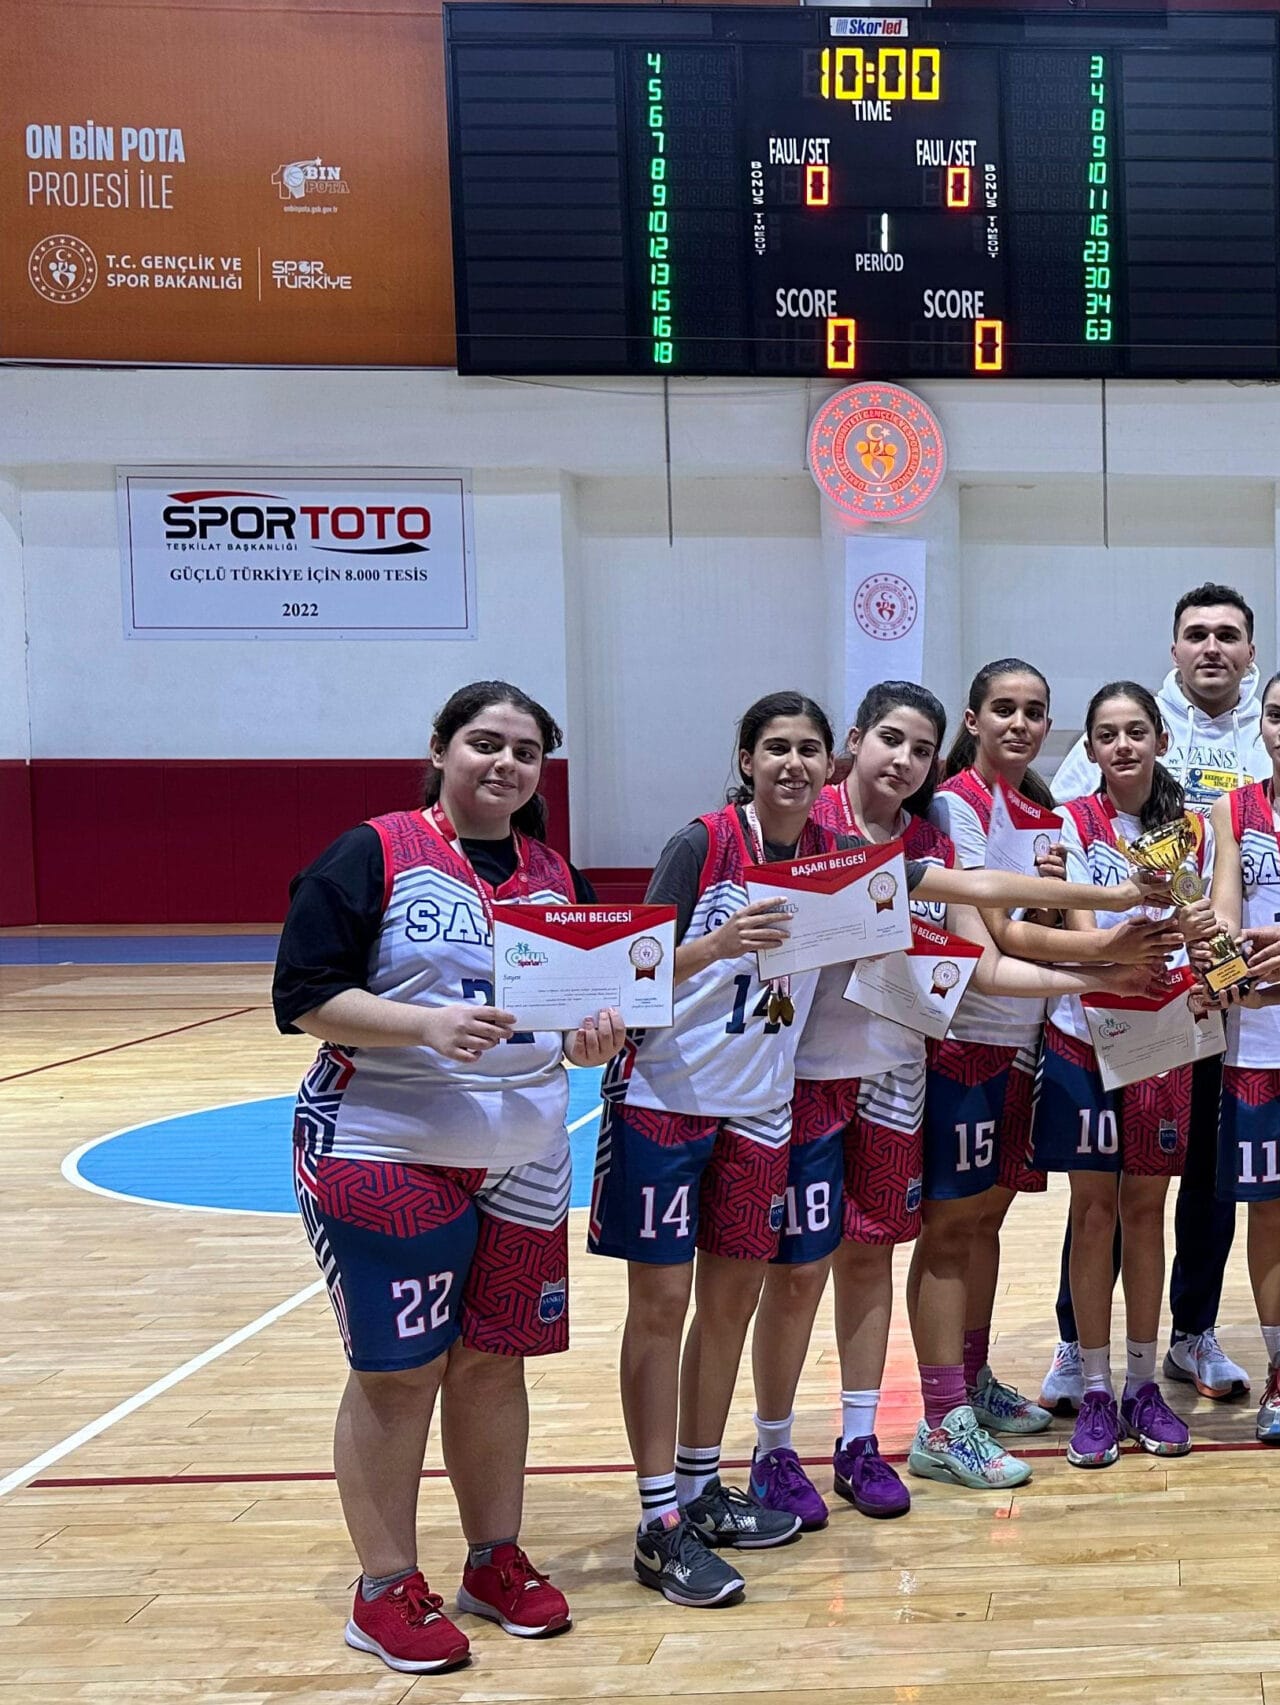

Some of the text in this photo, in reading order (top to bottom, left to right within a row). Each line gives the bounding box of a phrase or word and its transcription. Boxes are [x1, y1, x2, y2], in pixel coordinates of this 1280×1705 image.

[849, 19, 902, 35] Skorled
[647, 53, 661, 74] 4
[821, 47, 940, 100] 10:00
[1090, 55, 1104, 78] 3
[649, 79, 662, 101] 5
[1091, 82, 1104, 105] 4
[649, 105, 663, 128] 6
[852, 100, 892, 121] TIME
[1091, 108, 1105, 131] 8
[25, 120, 186, 164] ON BİN POTA
[652, 132, 665, 153] 7
[769, 138, 829, 165] FAUL/SET
[916, 139, 976, 167] FAUL/SET
[1092, 135, 1106, 158] 9
[651, 158, 666, 180] 8
[1089, 162, 1107, 184] 10
[28, 169, 174, 209] PROJESİ İLE
[306, 180, 350, 194] POTA
[751, 161, 764, 205] BONUS
[807, 165, 829, 205] 0
[948, 167, 970, 207] 0
[984, 163, 997, 208] BONUS
[652, 184, 666, 206] 9
[1089, 188, 1108, 210] 11
[648, 211, 668, 233] 10
[881, 213, 889, 252] 1
[1090, 214, 1108, 236] 16
[753, 212, 766, 256] TIMEOUT
[987, 215, 999, 258] TIMEOUT
[650, 237, 669, 259] 12
[1083, 240, 1109, 263] 23
[106, 253, 243, 274] T.C. GENÇLİK VE
[272, 260, 324, 275] SPOR
[651, 263, 670, 285] 13
[855, 253, 904, 272] PERIOD
[107, 272, 243, 290] SPOR BAKANLIĞI
[272, 272, 352, 290] TÜRKİYE
[1085, 267, 1110, 289] 30
[652, 290, 671, 311] 15
[776, 288, 837, 318] SCORE
[923, 289, 985, 320] SCORE
[1085, 293, 1111, 315] 34
[653, 315, 672, 337] 16
[1085, 319, 1112, 341] 63
[654, 341, 673, 364] 18
[827, 318, 856, 369] 0
[975, 319, 1002, 371] 0
[166, 542, 298, 553] TEŞKİLAT BAŞKANLIĞI
[170, 566, 428, 585] GÜÇLÜ TÜRKİYE İÇİN 8.000 TESİS
[282, 603, 319, 618] 2022
[1177, 746, 1239, 769] VANS
[791, 851, 867, 876] BAŞARI BELGESİ
[545, 910, 632, 925] BAŞARI BELGESİ
[918, 926, 948, 946] BELGESİ
[1077, 1109, 1118, 1155] 10
[954, 1120, 996, 1172] 15
[1237, 1141, 1280, 1184] 11
[639, 1185, 690, 1239] 14
[784, 1181, 831, 1236] 18
[392, 1271, 454, 1338] 22
